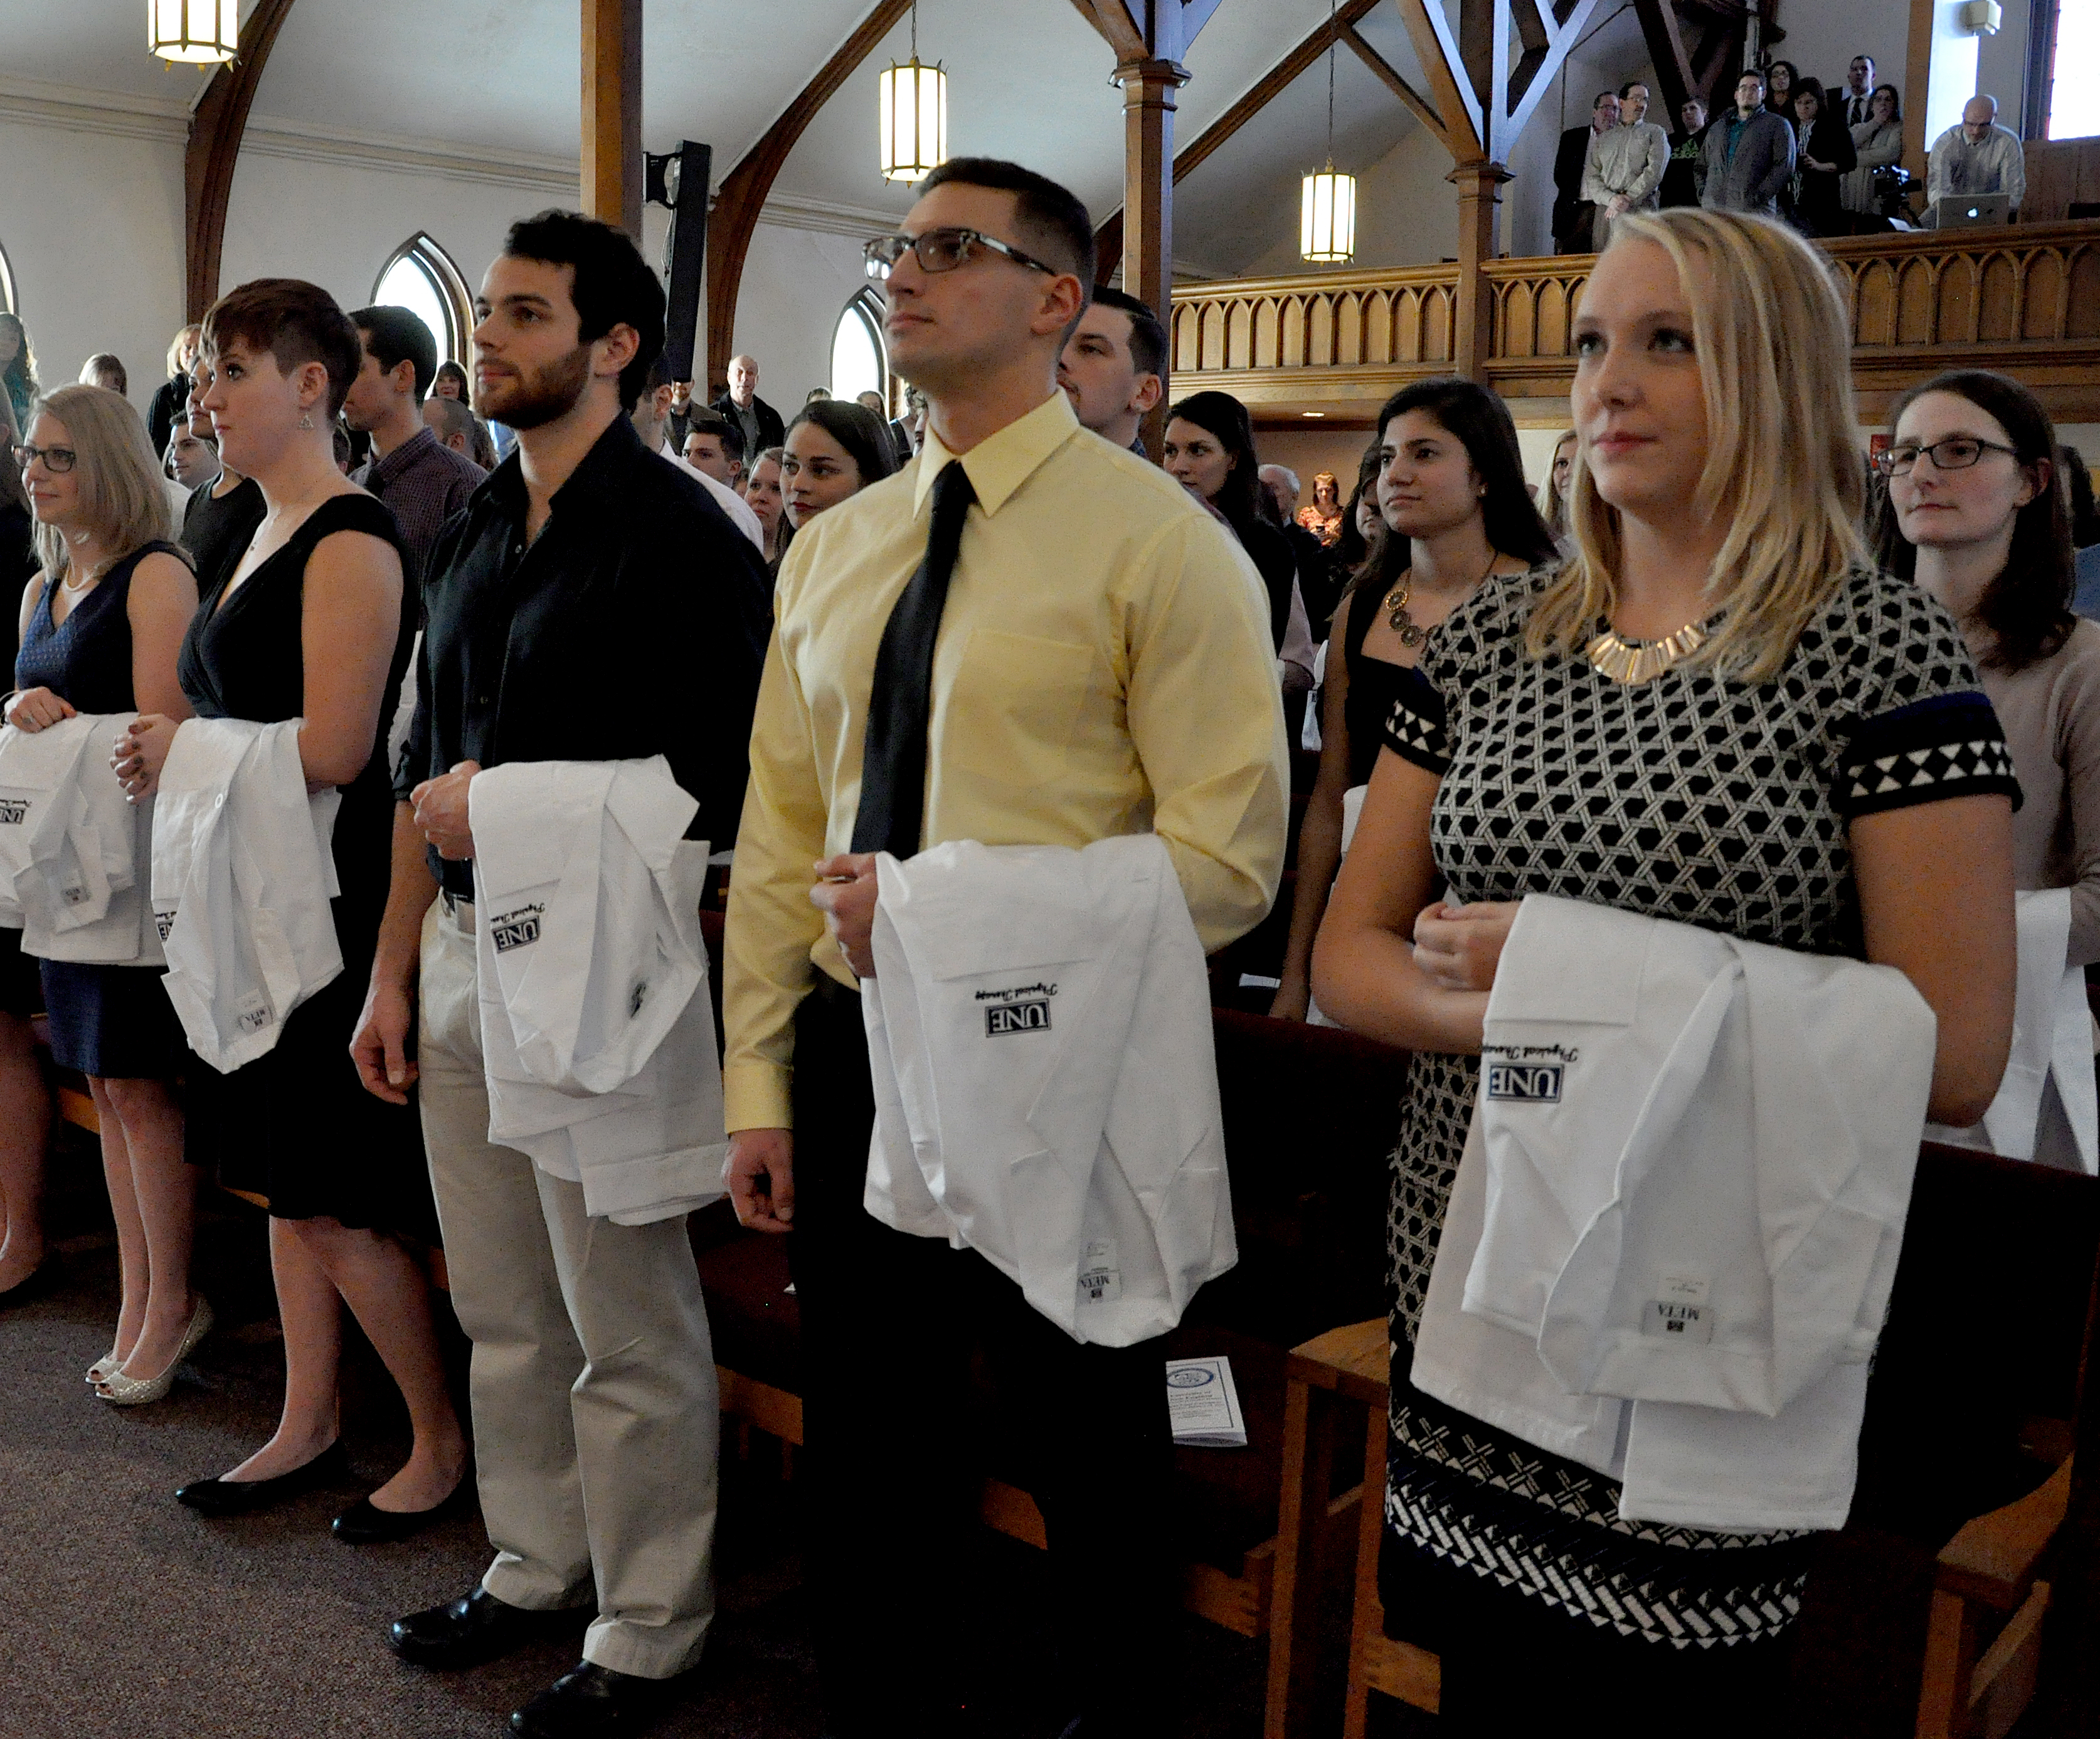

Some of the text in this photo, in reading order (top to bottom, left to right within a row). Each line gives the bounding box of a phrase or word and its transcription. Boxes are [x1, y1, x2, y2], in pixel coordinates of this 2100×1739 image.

[511, 902, 545, 920] Physical
[494, 920, 538, 948] UNE
[975, 982, 1058, 1002] Physical Therapy
[990, 1004, 1047, 1032] UNE
[1522, 1044, 1579, 1062] Physical
[1490, 1066, 1557, 1097] UNE
[1080, 1275, 1110, 1289] META
[1658, 1304, 1700, 1321] META
